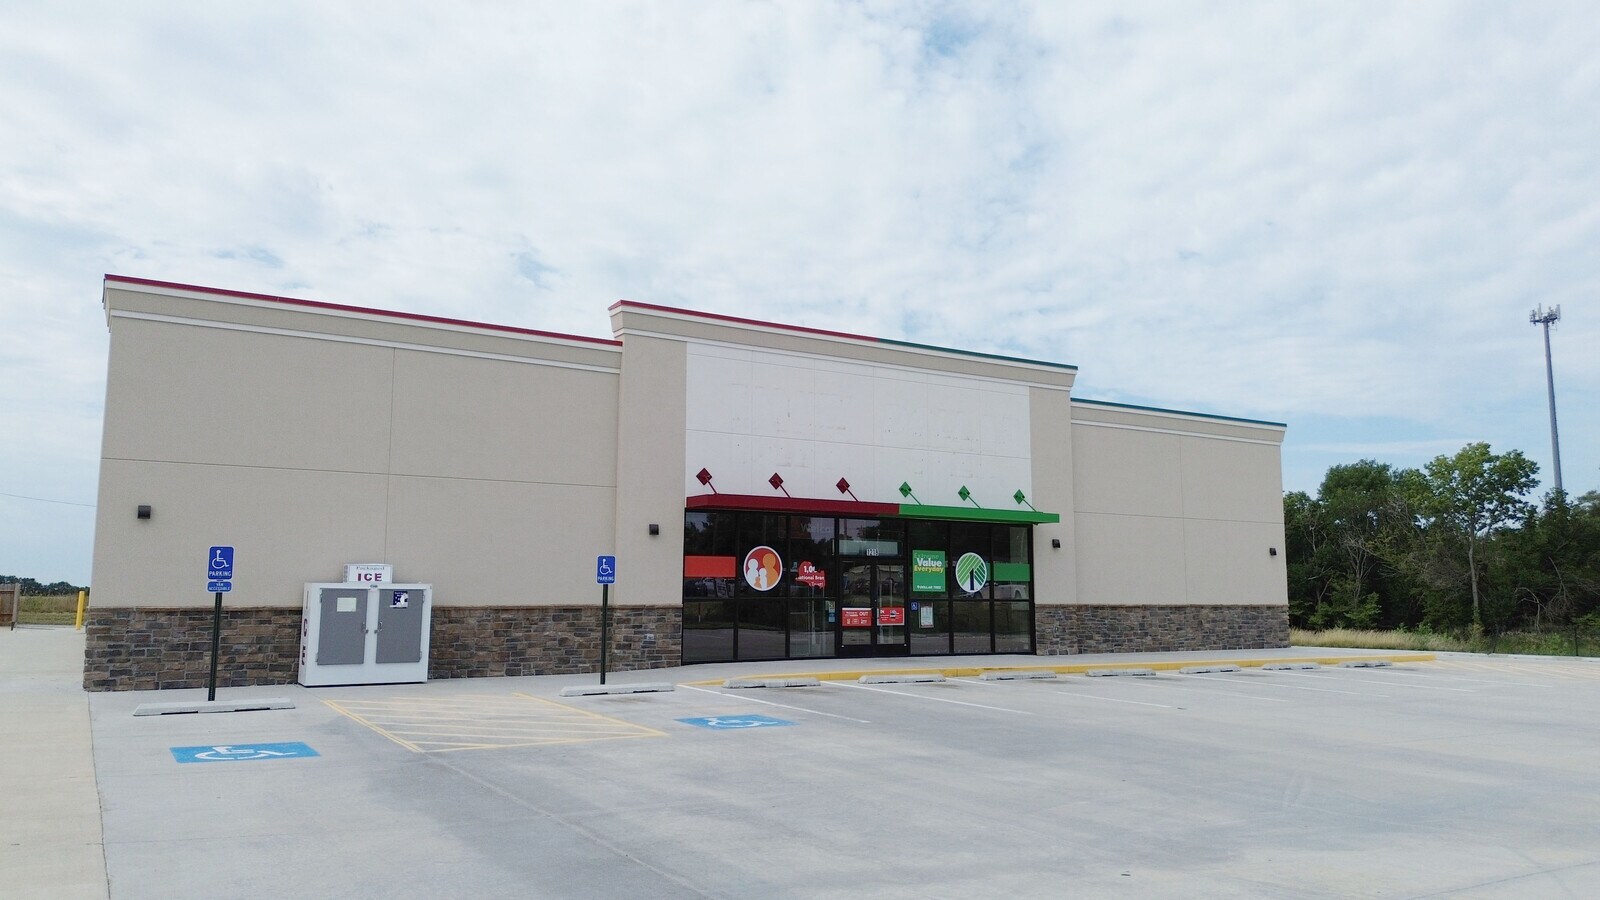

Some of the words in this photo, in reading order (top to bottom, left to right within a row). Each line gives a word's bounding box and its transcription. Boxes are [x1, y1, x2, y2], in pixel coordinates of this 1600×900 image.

[916, 557, 943, 567] Value
[913, 565, 945, 574] Everyday
[357, 573, 383, 581] ICE
